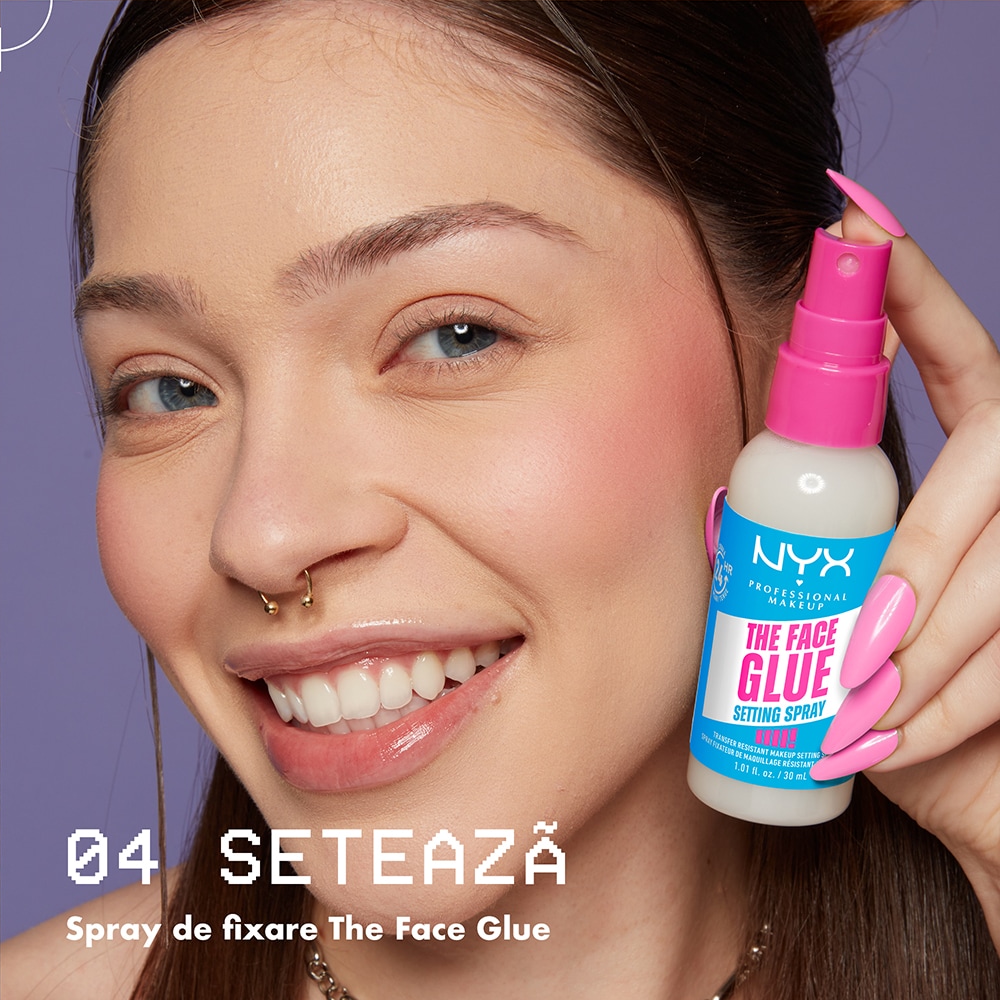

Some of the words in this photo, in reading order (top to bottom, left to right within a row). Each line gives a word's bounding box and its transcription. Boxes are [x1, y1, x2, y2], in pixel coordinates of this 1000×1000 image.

[752, 534, 855, 578] NYX
[748, 579, 847, 602] PROFESSIONAL
[768, 596, 824, 611] MAKEUP
[746, 622, 780, 651] THE
[786, 617, 839, 650] FACE
[737, 647, 835, 703] GLUE
[733, 704, 781, 723] SETTING
[785, 700, 827, 722] SPRAY
[701, 732, 713, 745] SPRAY
[712, 739, 735, 756] FIXATEUR
[735, 750, 742, 759] DE
[743, 753, 781, 767] MAQUILLAGE
[782, 760, 815, 769] RÉSISTANT
[713, 731, 737, 747] TRANSFER
[737, 741, 769, 756] RESISTANT
[770, 750, 796, 759] MAKEUP
[797, 751, 821, 759] SETTING
[734, 761, 750, 773] 1.01
[752, 766, 760, 776] fl.
[762, 770, 775, 778] oz.
[783, 771, 794, 780] 30
[795, 772, 807, 780] mL
